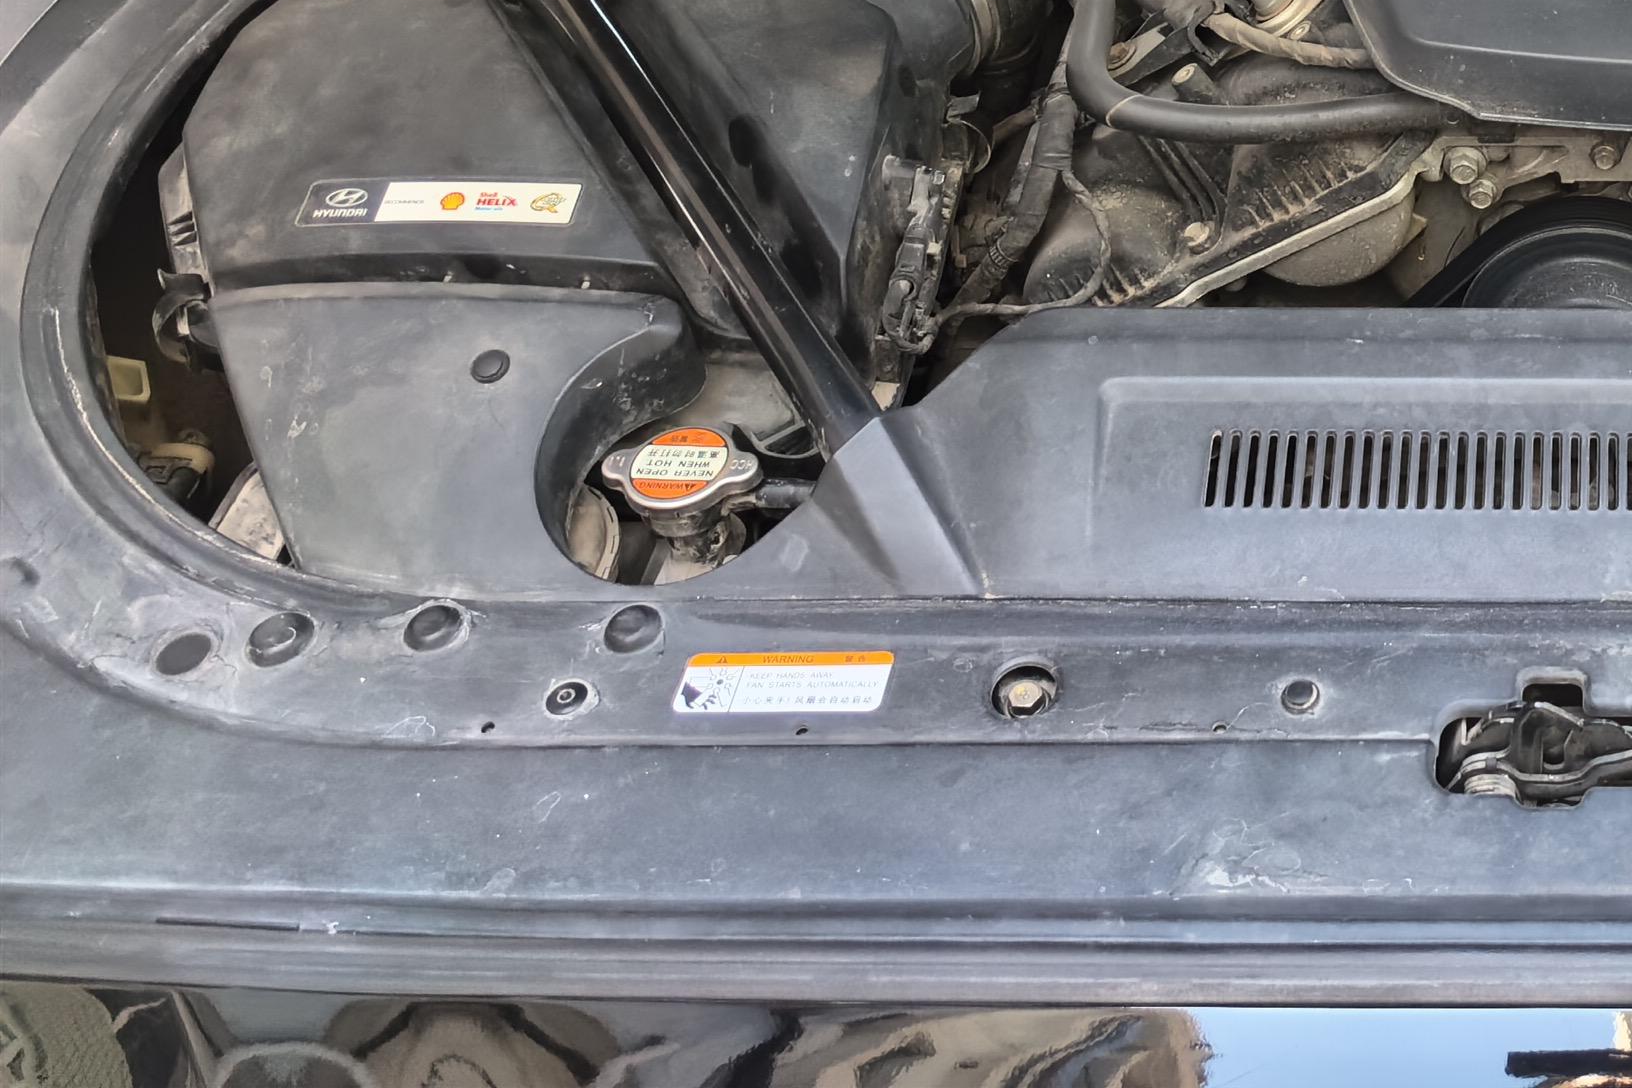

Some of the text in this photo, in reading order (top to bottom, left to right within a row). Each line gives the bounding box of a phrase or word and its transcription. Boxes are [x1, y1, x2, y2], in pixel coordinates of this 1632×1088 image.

[476, 196, 518, 206] HELIX
[313, 208, 368, 218] HYUNDAI
[678, 460, 710, 468] WHEN
[636, 468, 714, 477] NEVER OPEN
[639, 482, 684, 490] WARNING
[762, 655, 815, 664] WARNING
